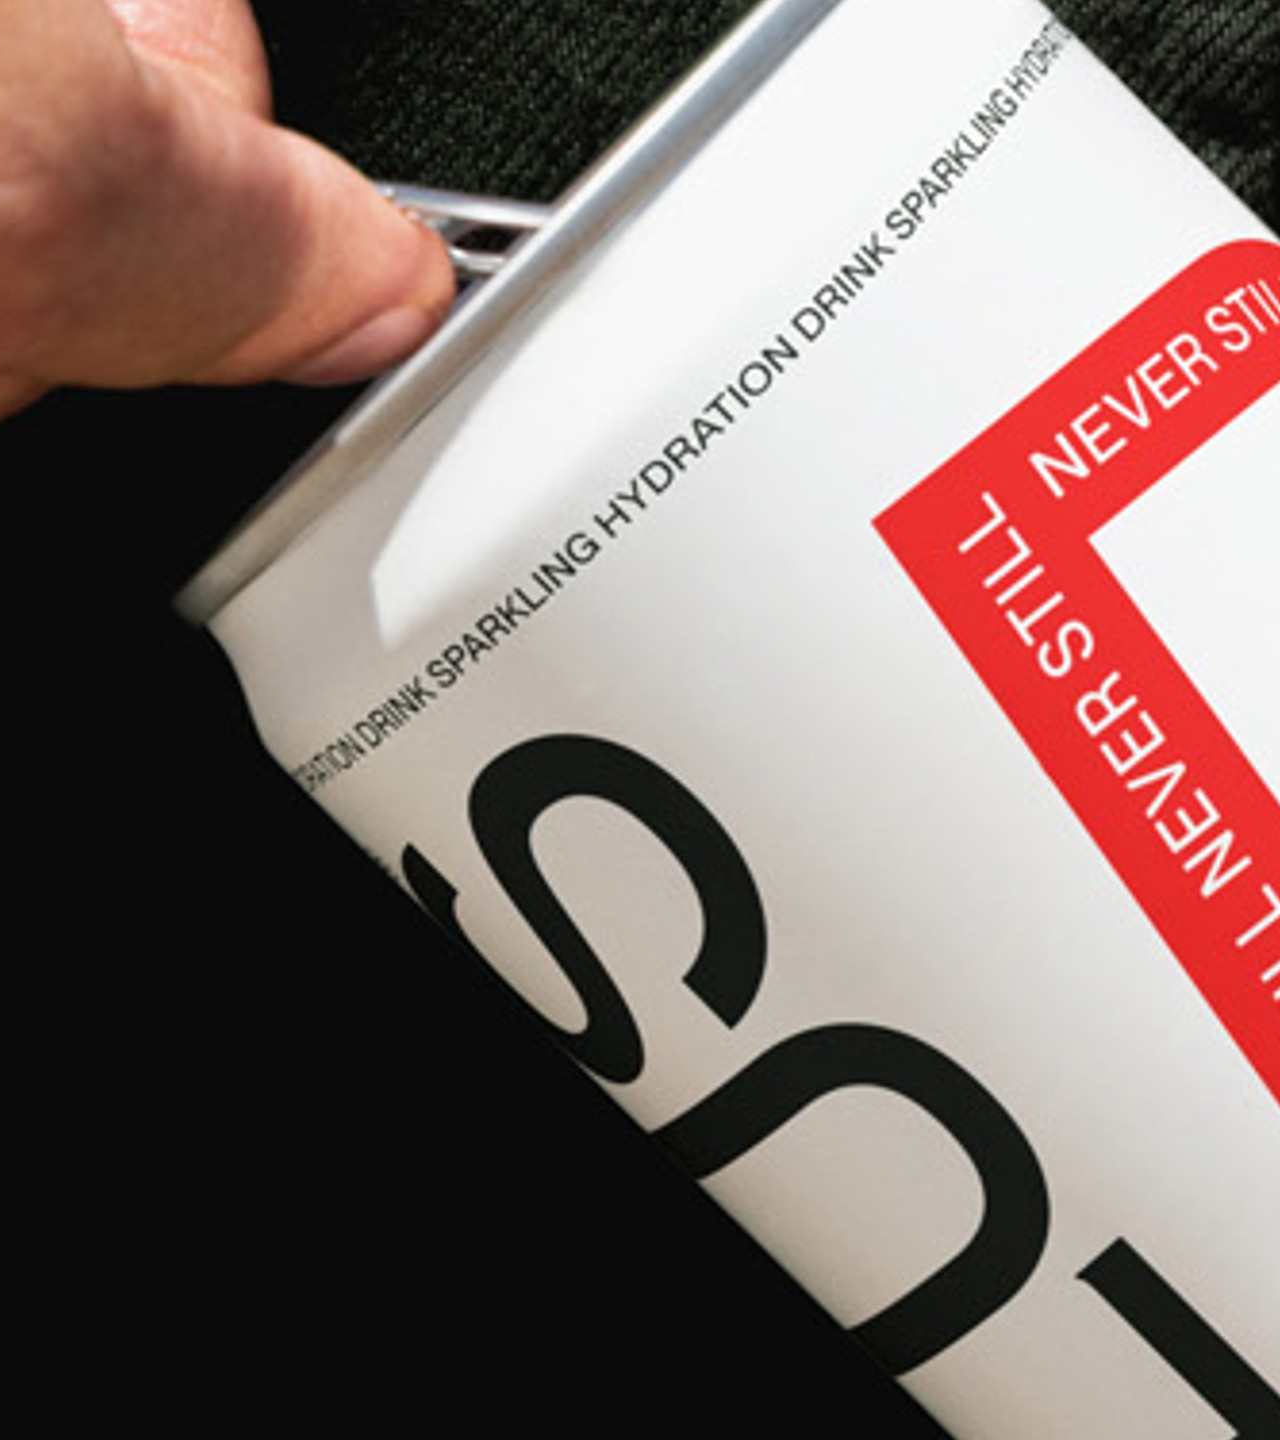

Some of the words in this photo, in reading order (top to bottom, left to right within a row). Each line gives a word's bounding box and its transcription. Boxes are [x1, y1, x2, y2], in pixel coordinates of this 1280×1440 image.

[354, 676, 437, 749] DRINK
[425, 532, 601, 689] SPARKLING
[593, 334, 799, 538] HYDRATION
[790, 232, 896, 342] DRINK
[885, 87, 1019, 240] SPARKLING
[1028, 331, 1219, 498] NEVER
[957, 491, 1095, 677] STILL
[1075, 671, 1252, 898] NEVER
